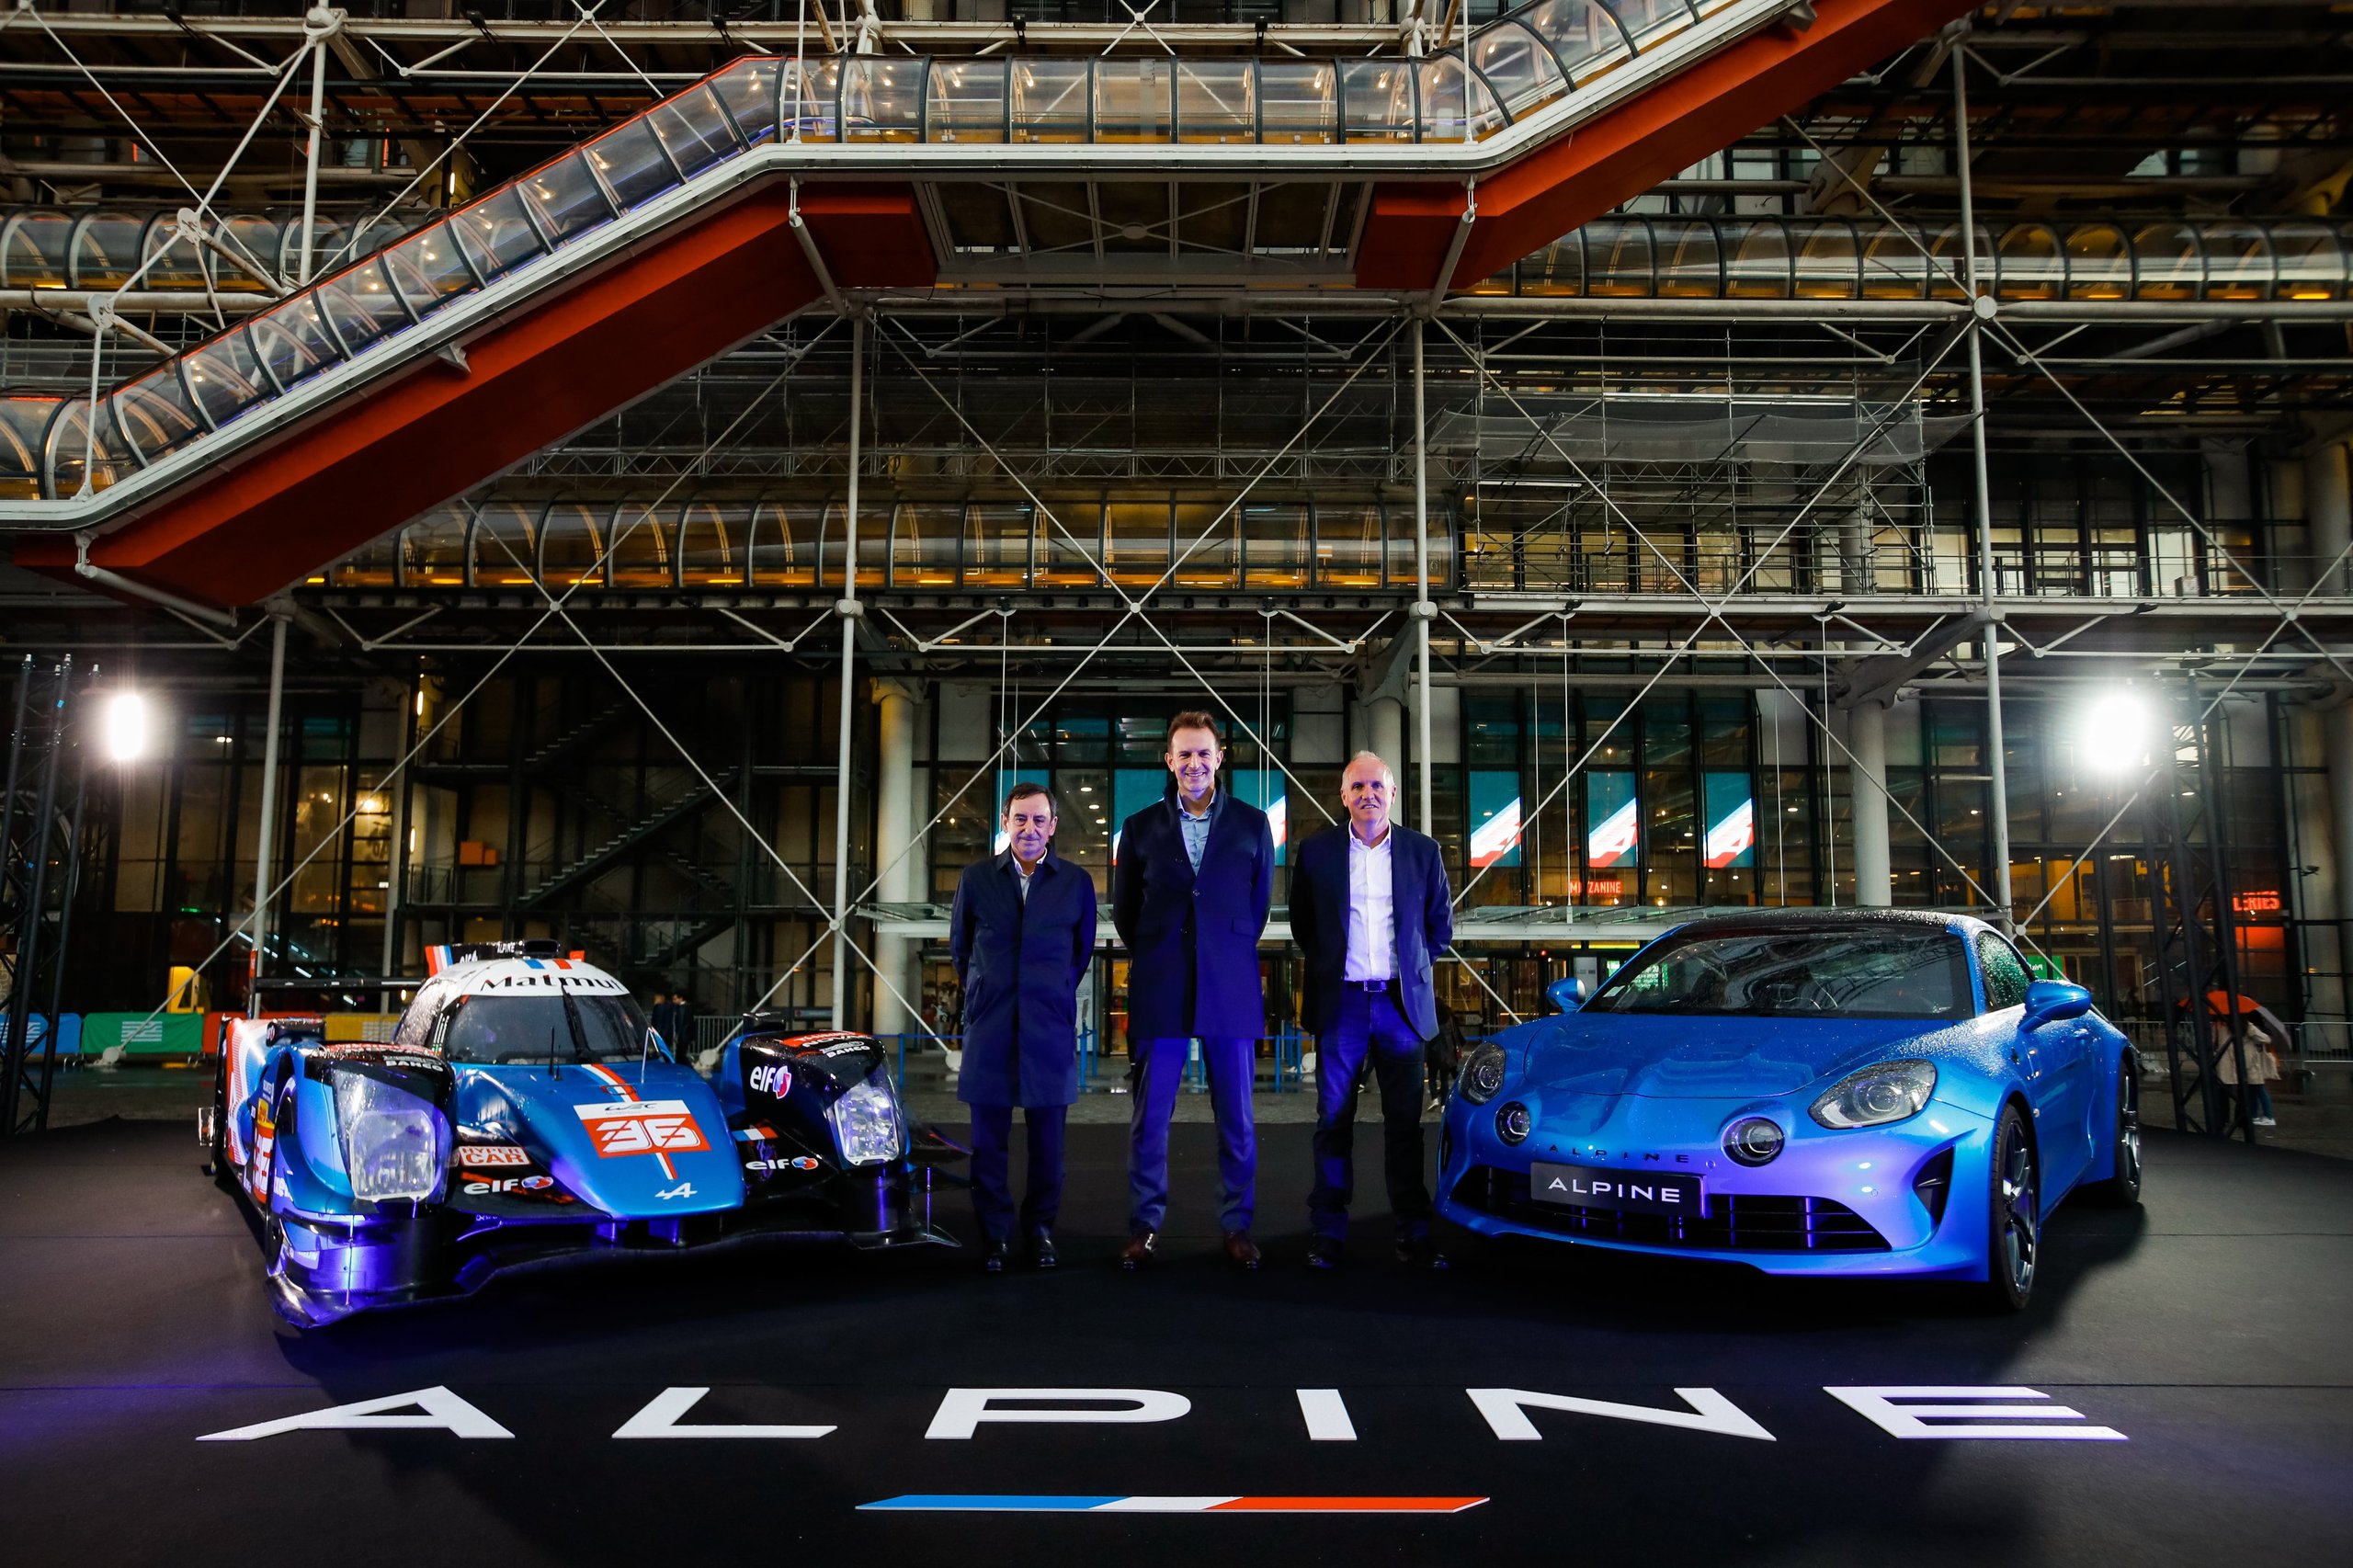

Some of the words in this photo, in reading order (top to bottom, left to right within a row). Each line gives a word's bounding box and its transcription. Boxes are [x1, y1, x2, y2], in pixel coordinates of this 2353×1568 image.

[1570, 881, 1621, 894] MZANINE
[480, 973, 625, 993] Matmut
[826, 1045, 870, 1058] BAHCO
[385, 1060, 444, 1073] BAHCO
[750, 1065, 777, 1093] elf
[597, 1117, 701, 1153] 36
[465, 1153, 524, 1164] CAR
[1549, 1144, 1689, 1164] ALPINE
[745, 1158, 790, 1170] elf
[463, 1178, 519, 1195] elf
[1548, 1176, 1680, 1203] ALPINE
[195, 1385, 2130, 1441] ALPINE
